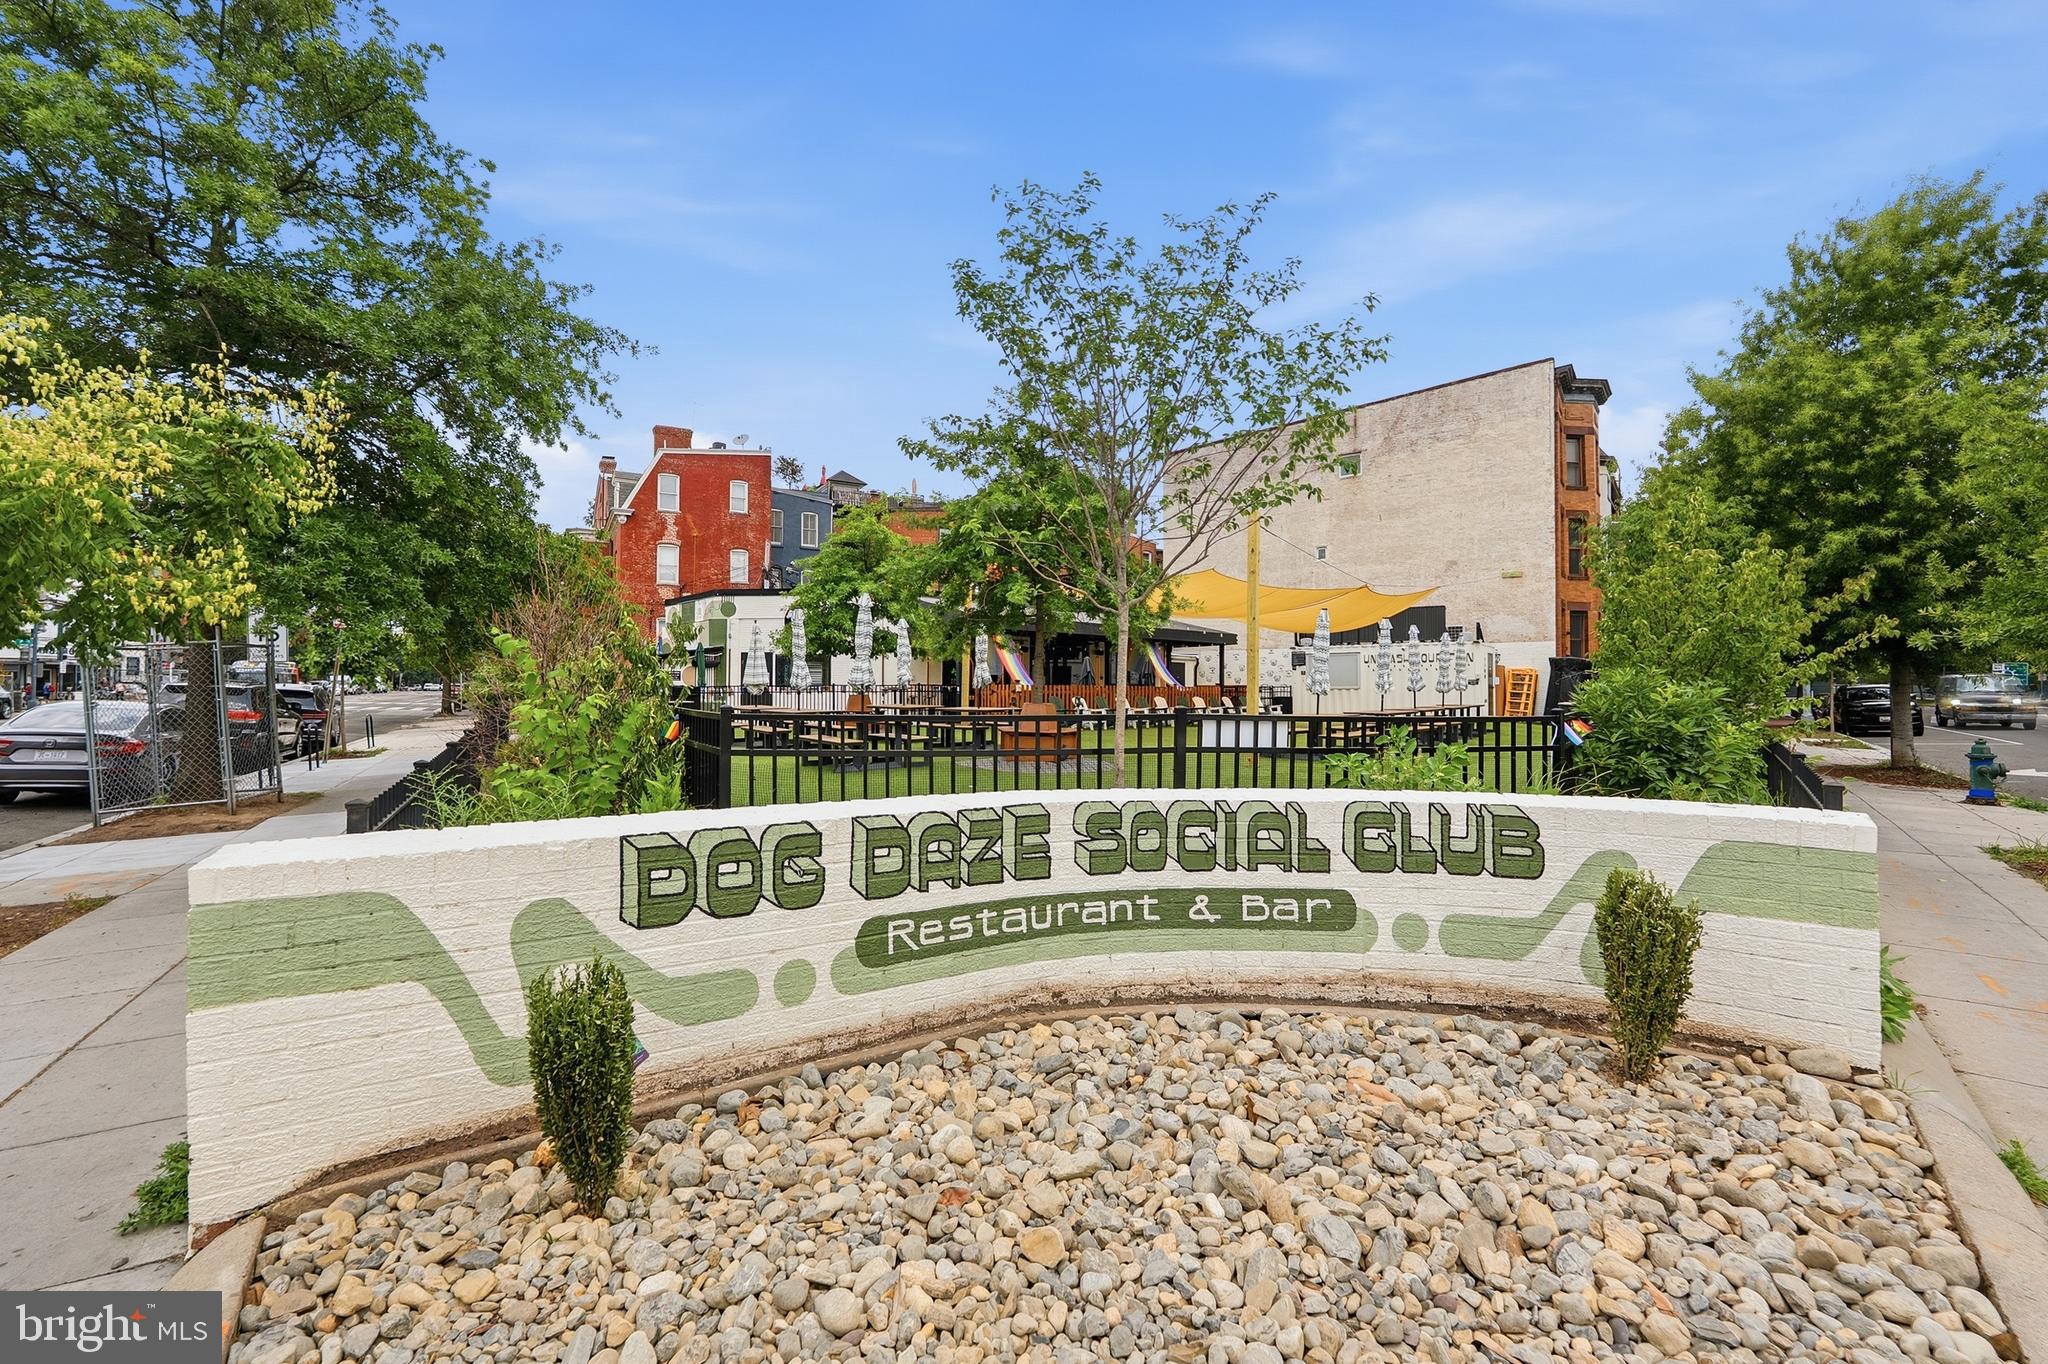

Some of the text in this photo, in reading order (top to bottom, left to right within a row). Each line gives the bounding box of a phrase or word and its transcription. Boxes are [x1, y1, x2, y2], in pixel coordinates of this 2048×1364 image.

[1363, 653, 1410, 664] UNASH
[619, 799, 1546, 930] DOG DAZE SOCIAL CLUB
[887, 893, 1332, 955] Restaurant & Bar
